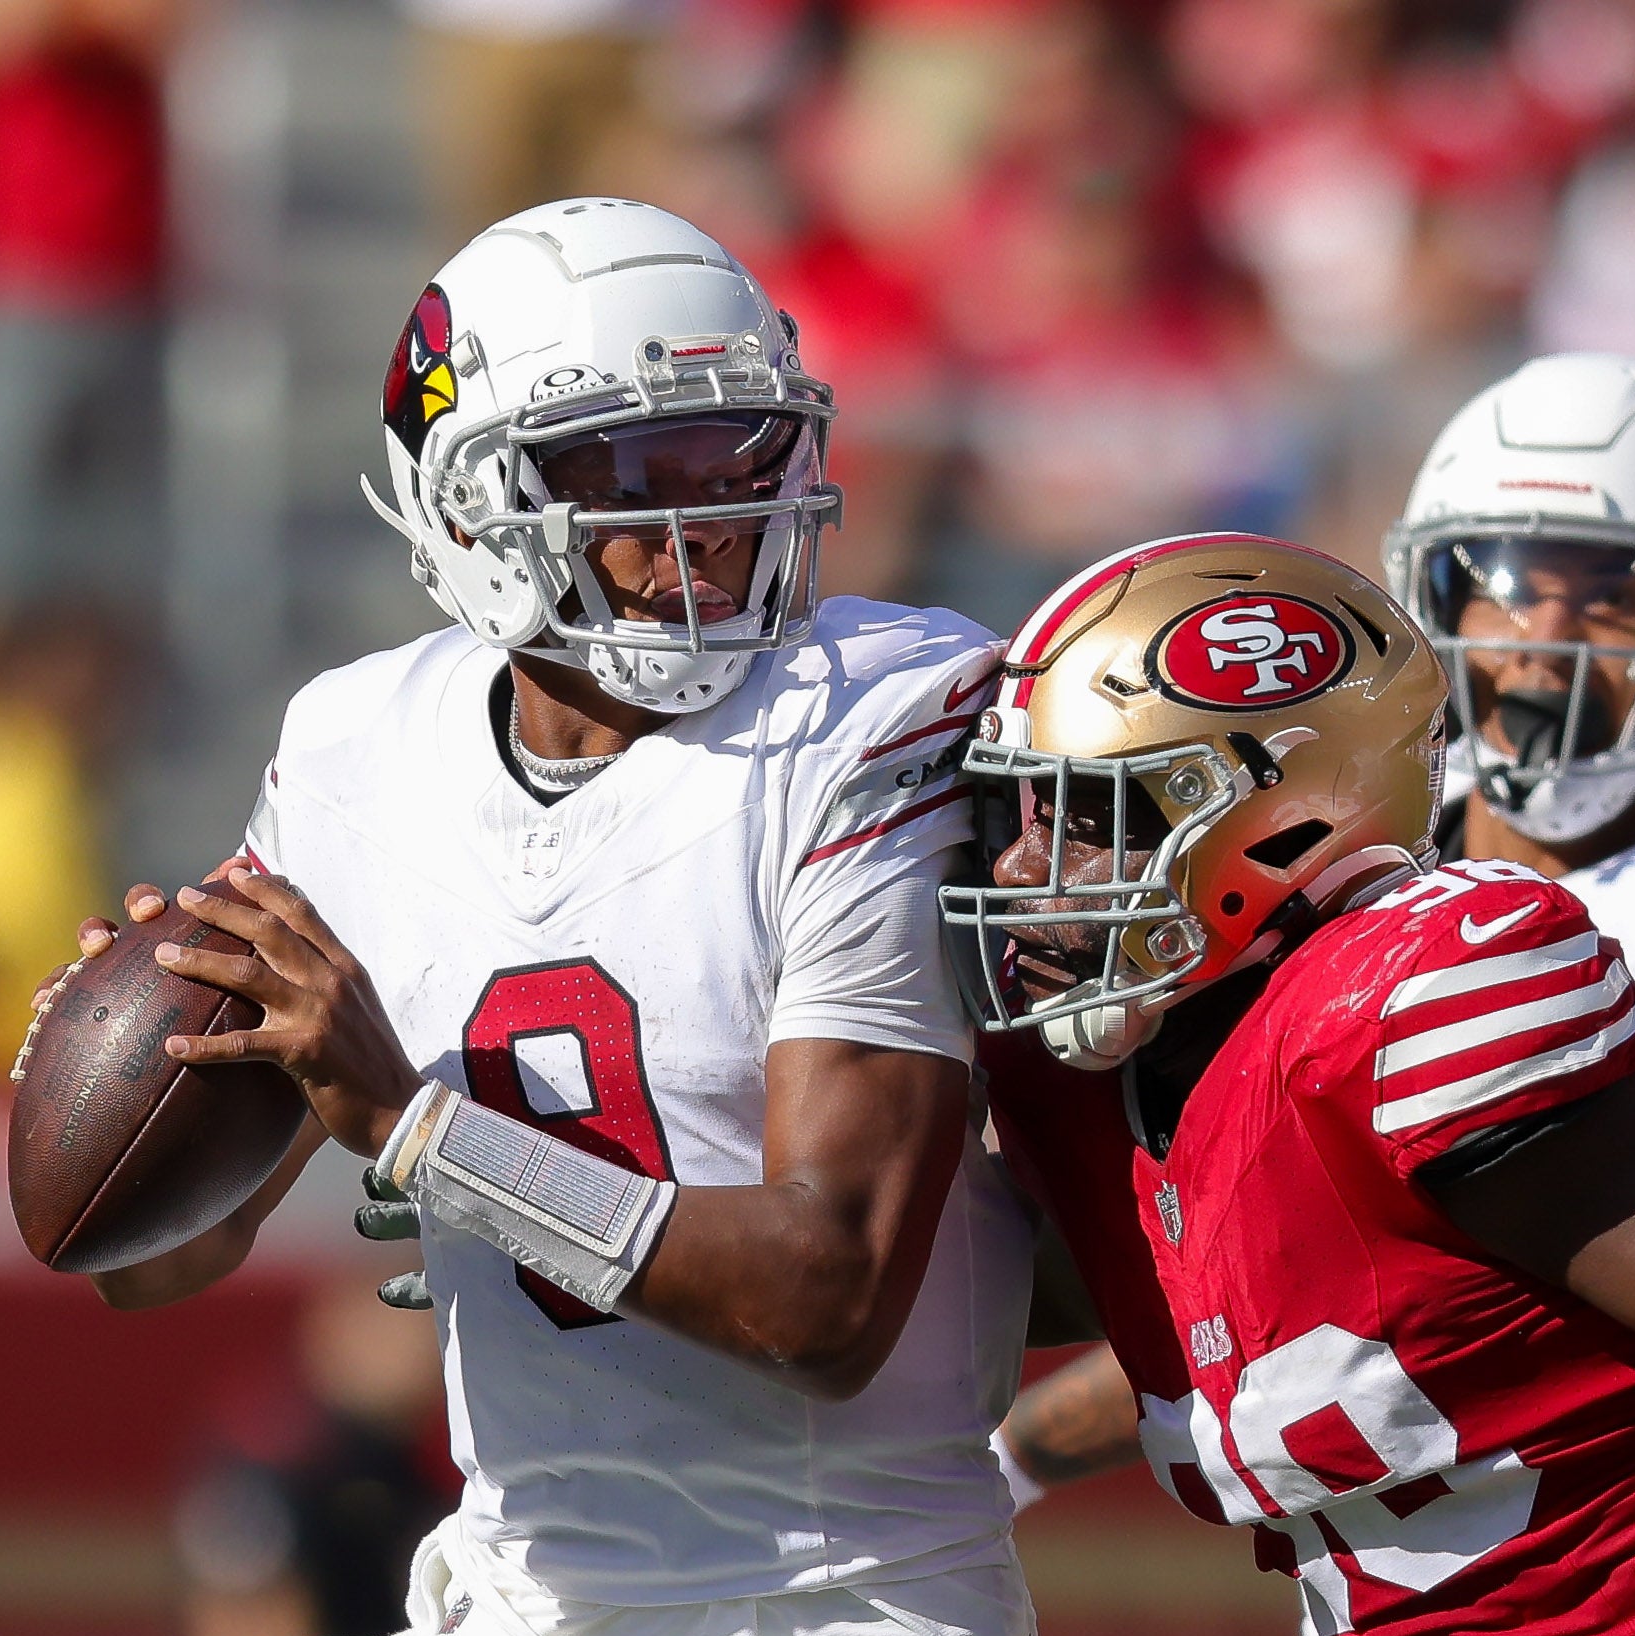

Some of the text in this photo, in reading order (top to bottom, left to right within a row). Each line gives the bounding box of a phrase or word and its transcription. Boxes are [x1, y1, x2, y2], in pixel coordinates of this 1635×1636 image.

[1200, 604, 1324, 697] SF
[60, 1065, 103, 1150] NATIONAL
[159, 926, 211, 976] LGUE
